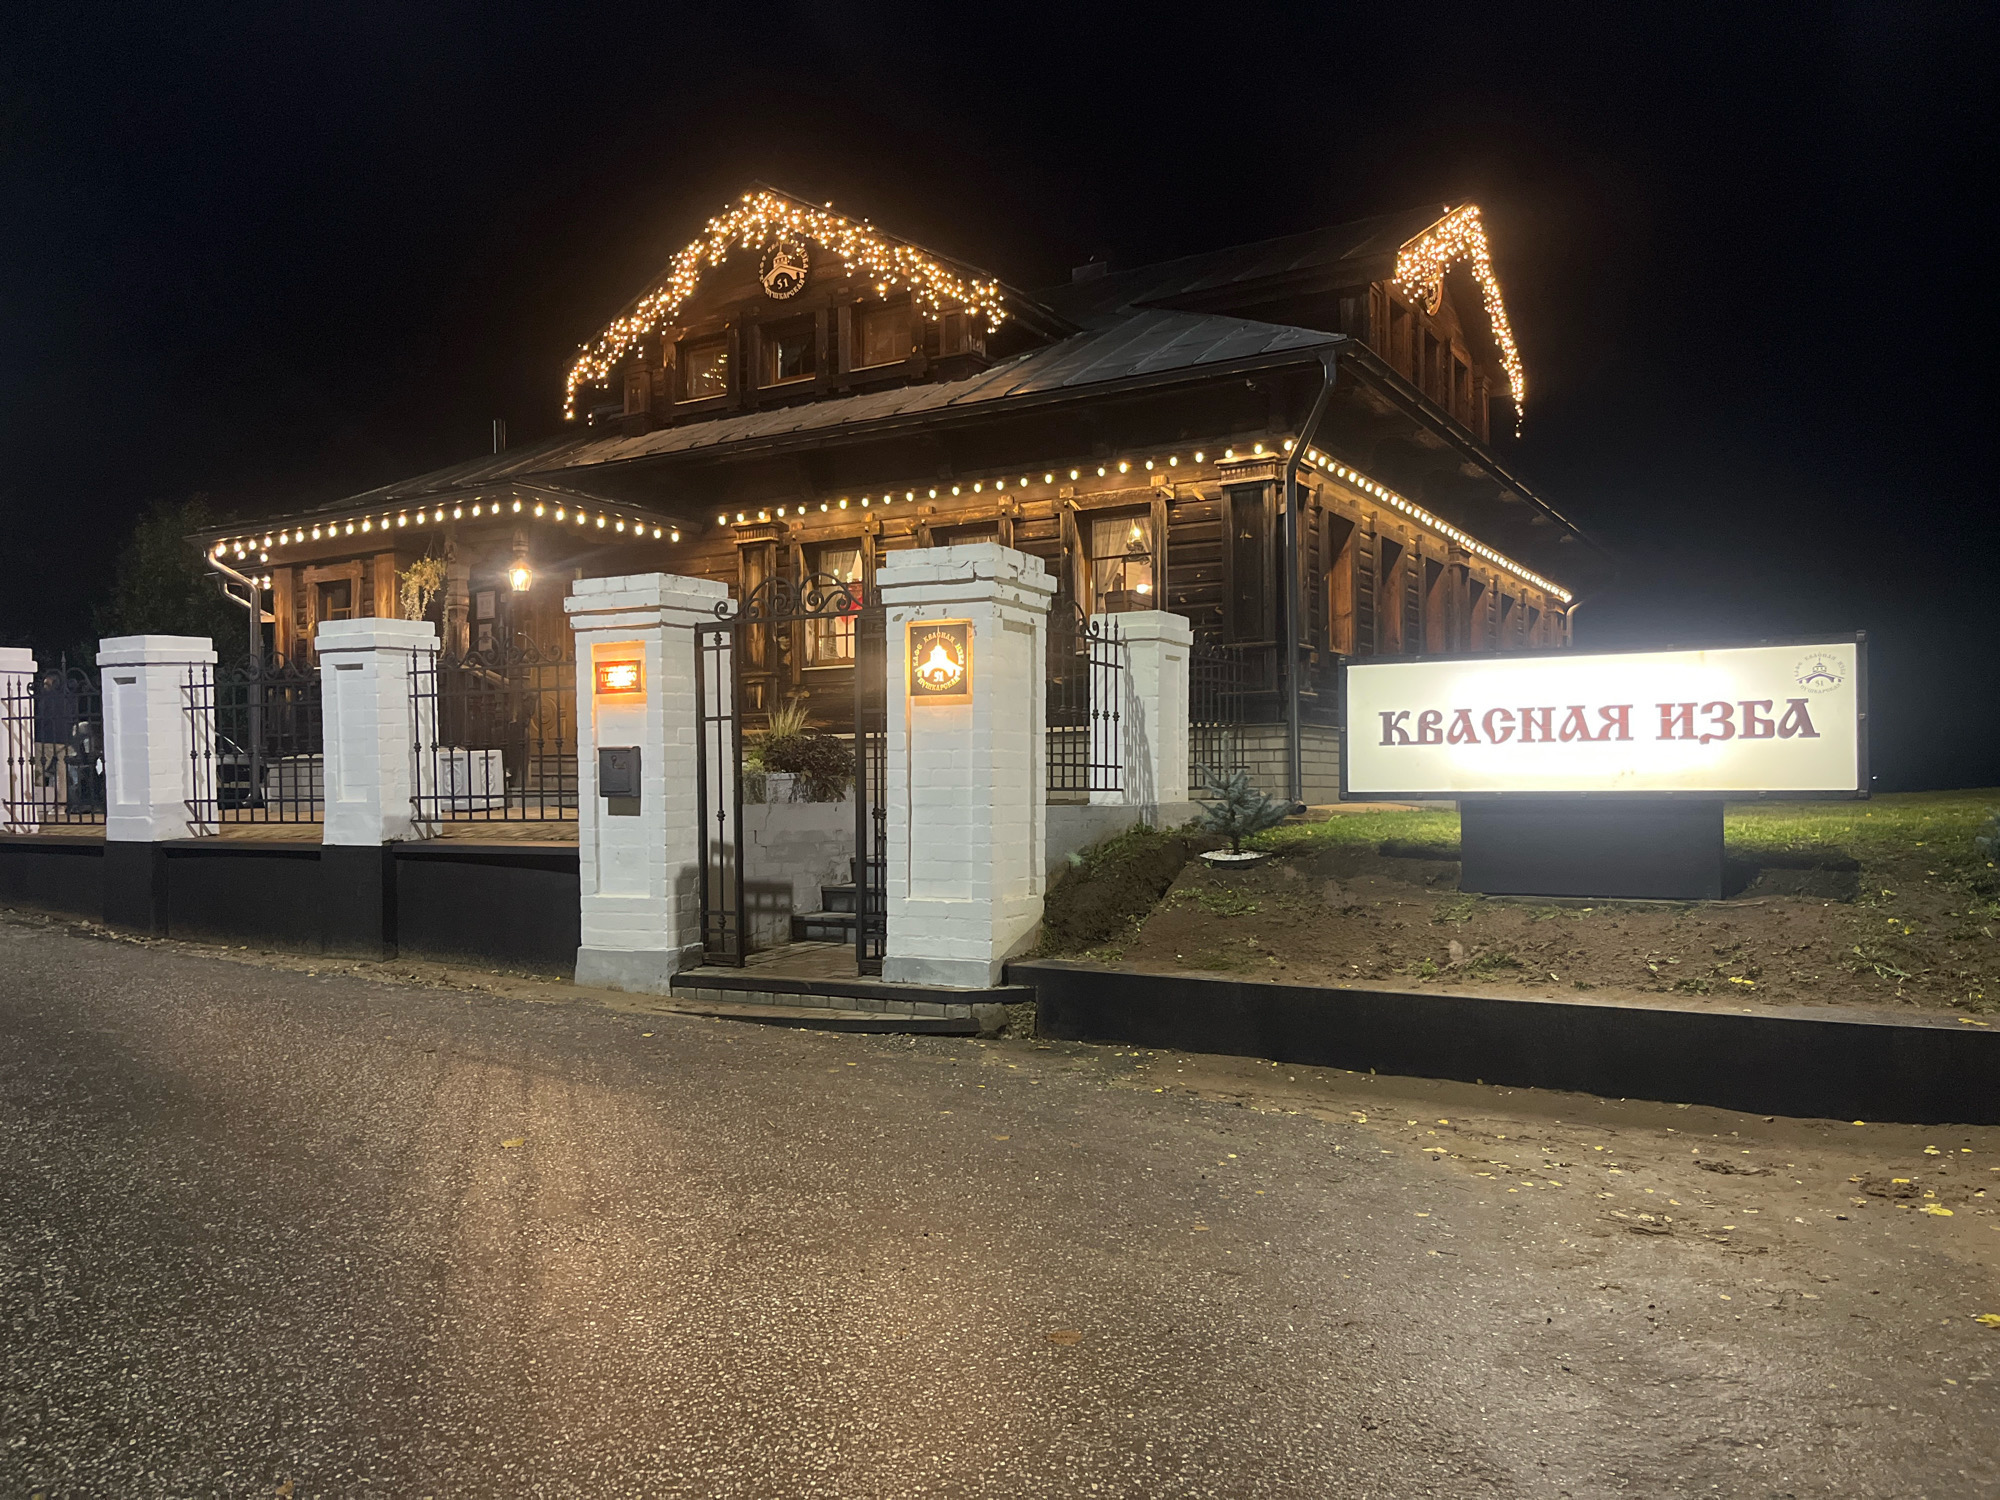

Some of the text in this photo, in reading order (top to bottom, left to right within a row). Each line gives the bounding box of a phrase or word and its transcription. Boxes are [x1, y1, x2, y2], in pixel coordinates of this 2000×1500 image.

[765, 279, 805, 299] ПУШКАРСКАЯ
[777, 278, 789, 290] 51
[923, 631, 956, 644] КВАСНАЯ
[917, 675, 961, 691] ПУШКАРСКАЯ
[933, 671, 944, 682] 51
[1378, 698, 1820, 746] КВАСНАЯ ИЗБА
